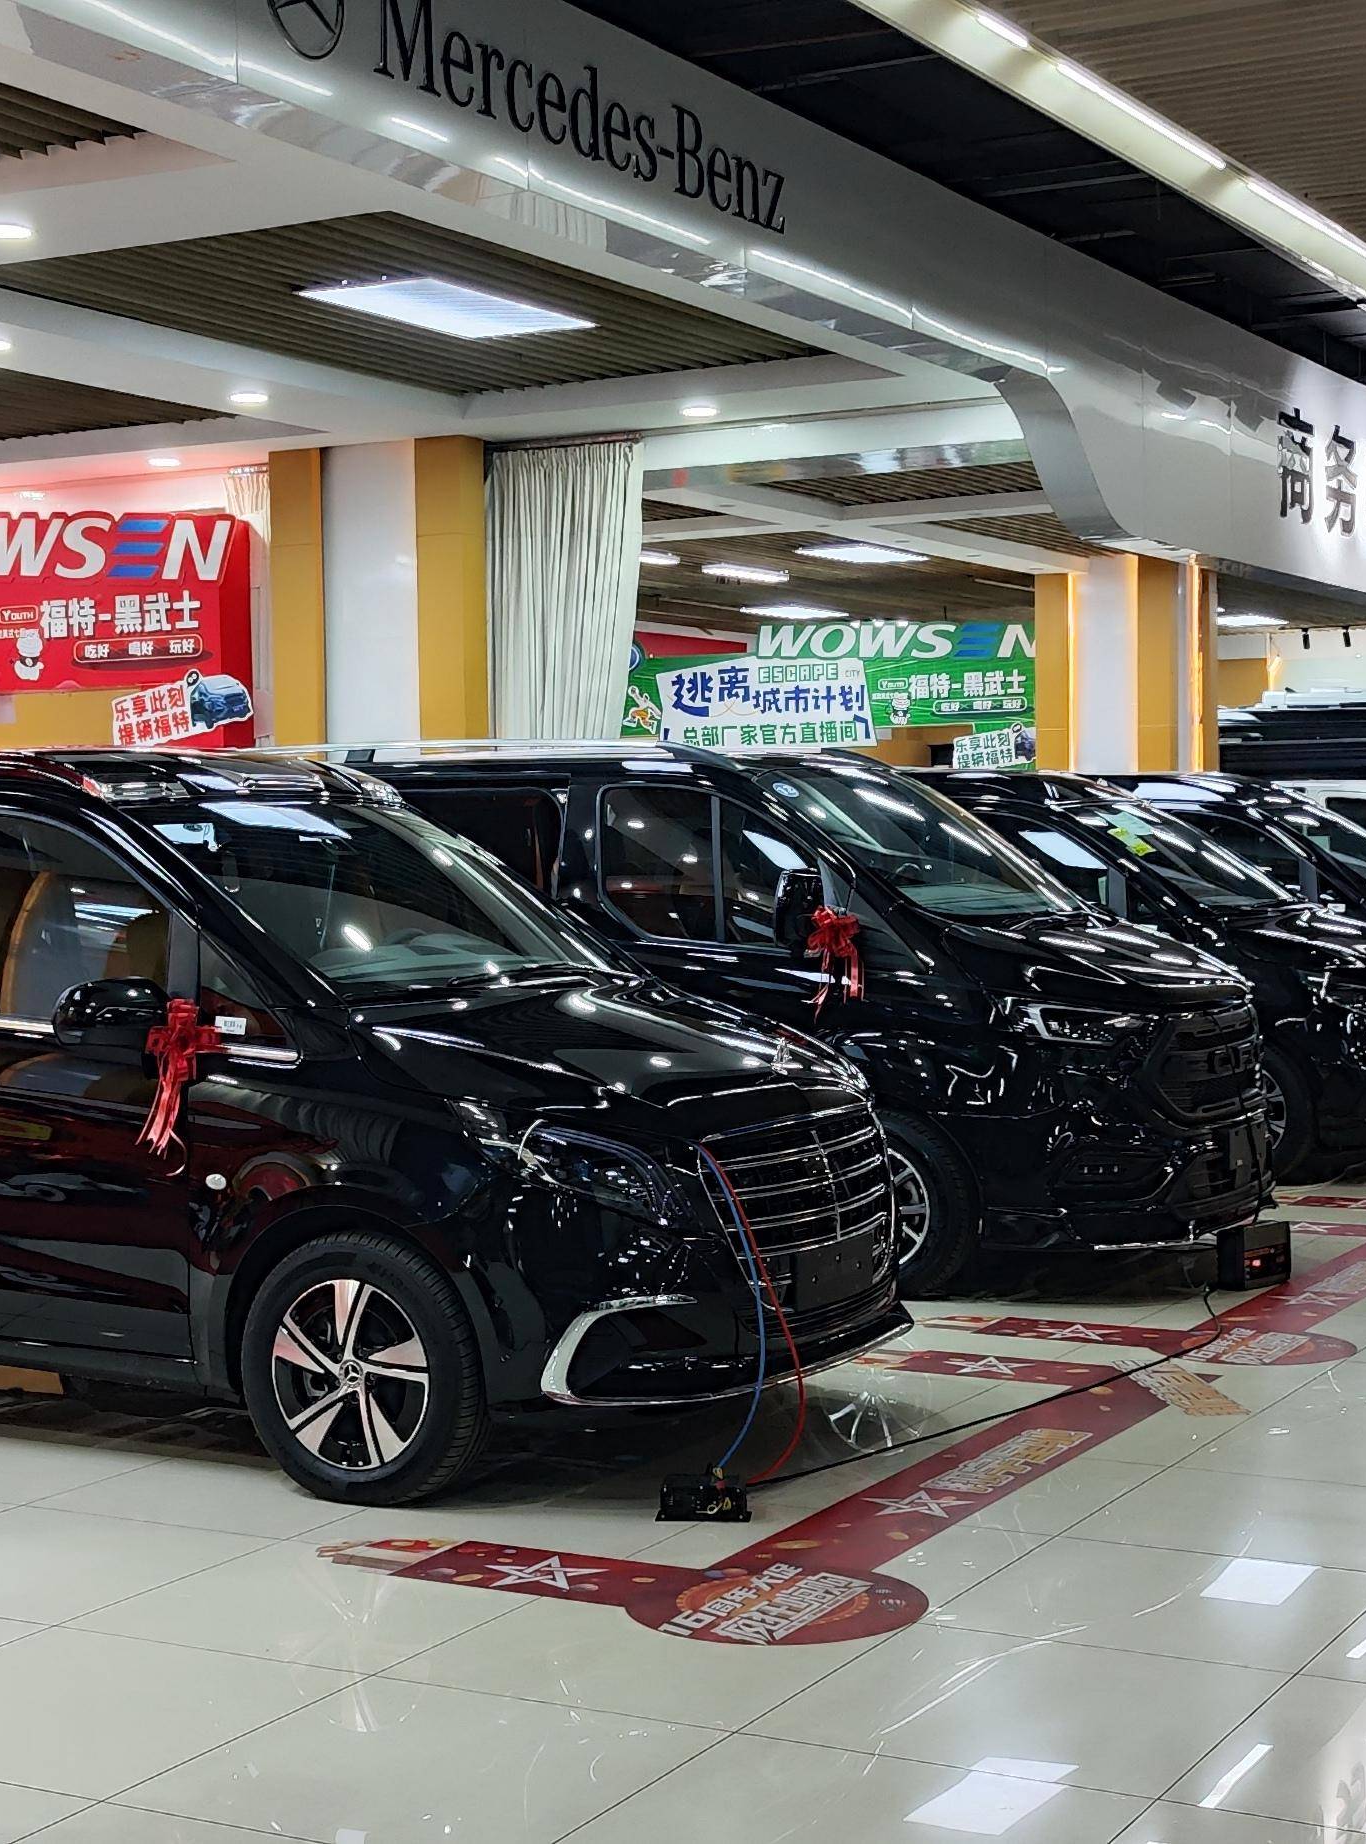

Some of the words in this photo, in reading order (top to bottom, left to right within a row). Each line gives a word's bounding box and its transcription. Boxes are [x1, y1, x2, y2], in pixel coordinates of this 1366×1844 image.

[374, 0, 786, 234] Mercedes-Benz
[40, 590, 201, 639] 福特-黑武士
[168, 638, 195, 654] 玩好
[758, 663, 839, 684] ESCAPE
[113, 684, 186, 723] 乐享此刻
[682, 718, 859, 747] 总部厂家官方直播间
